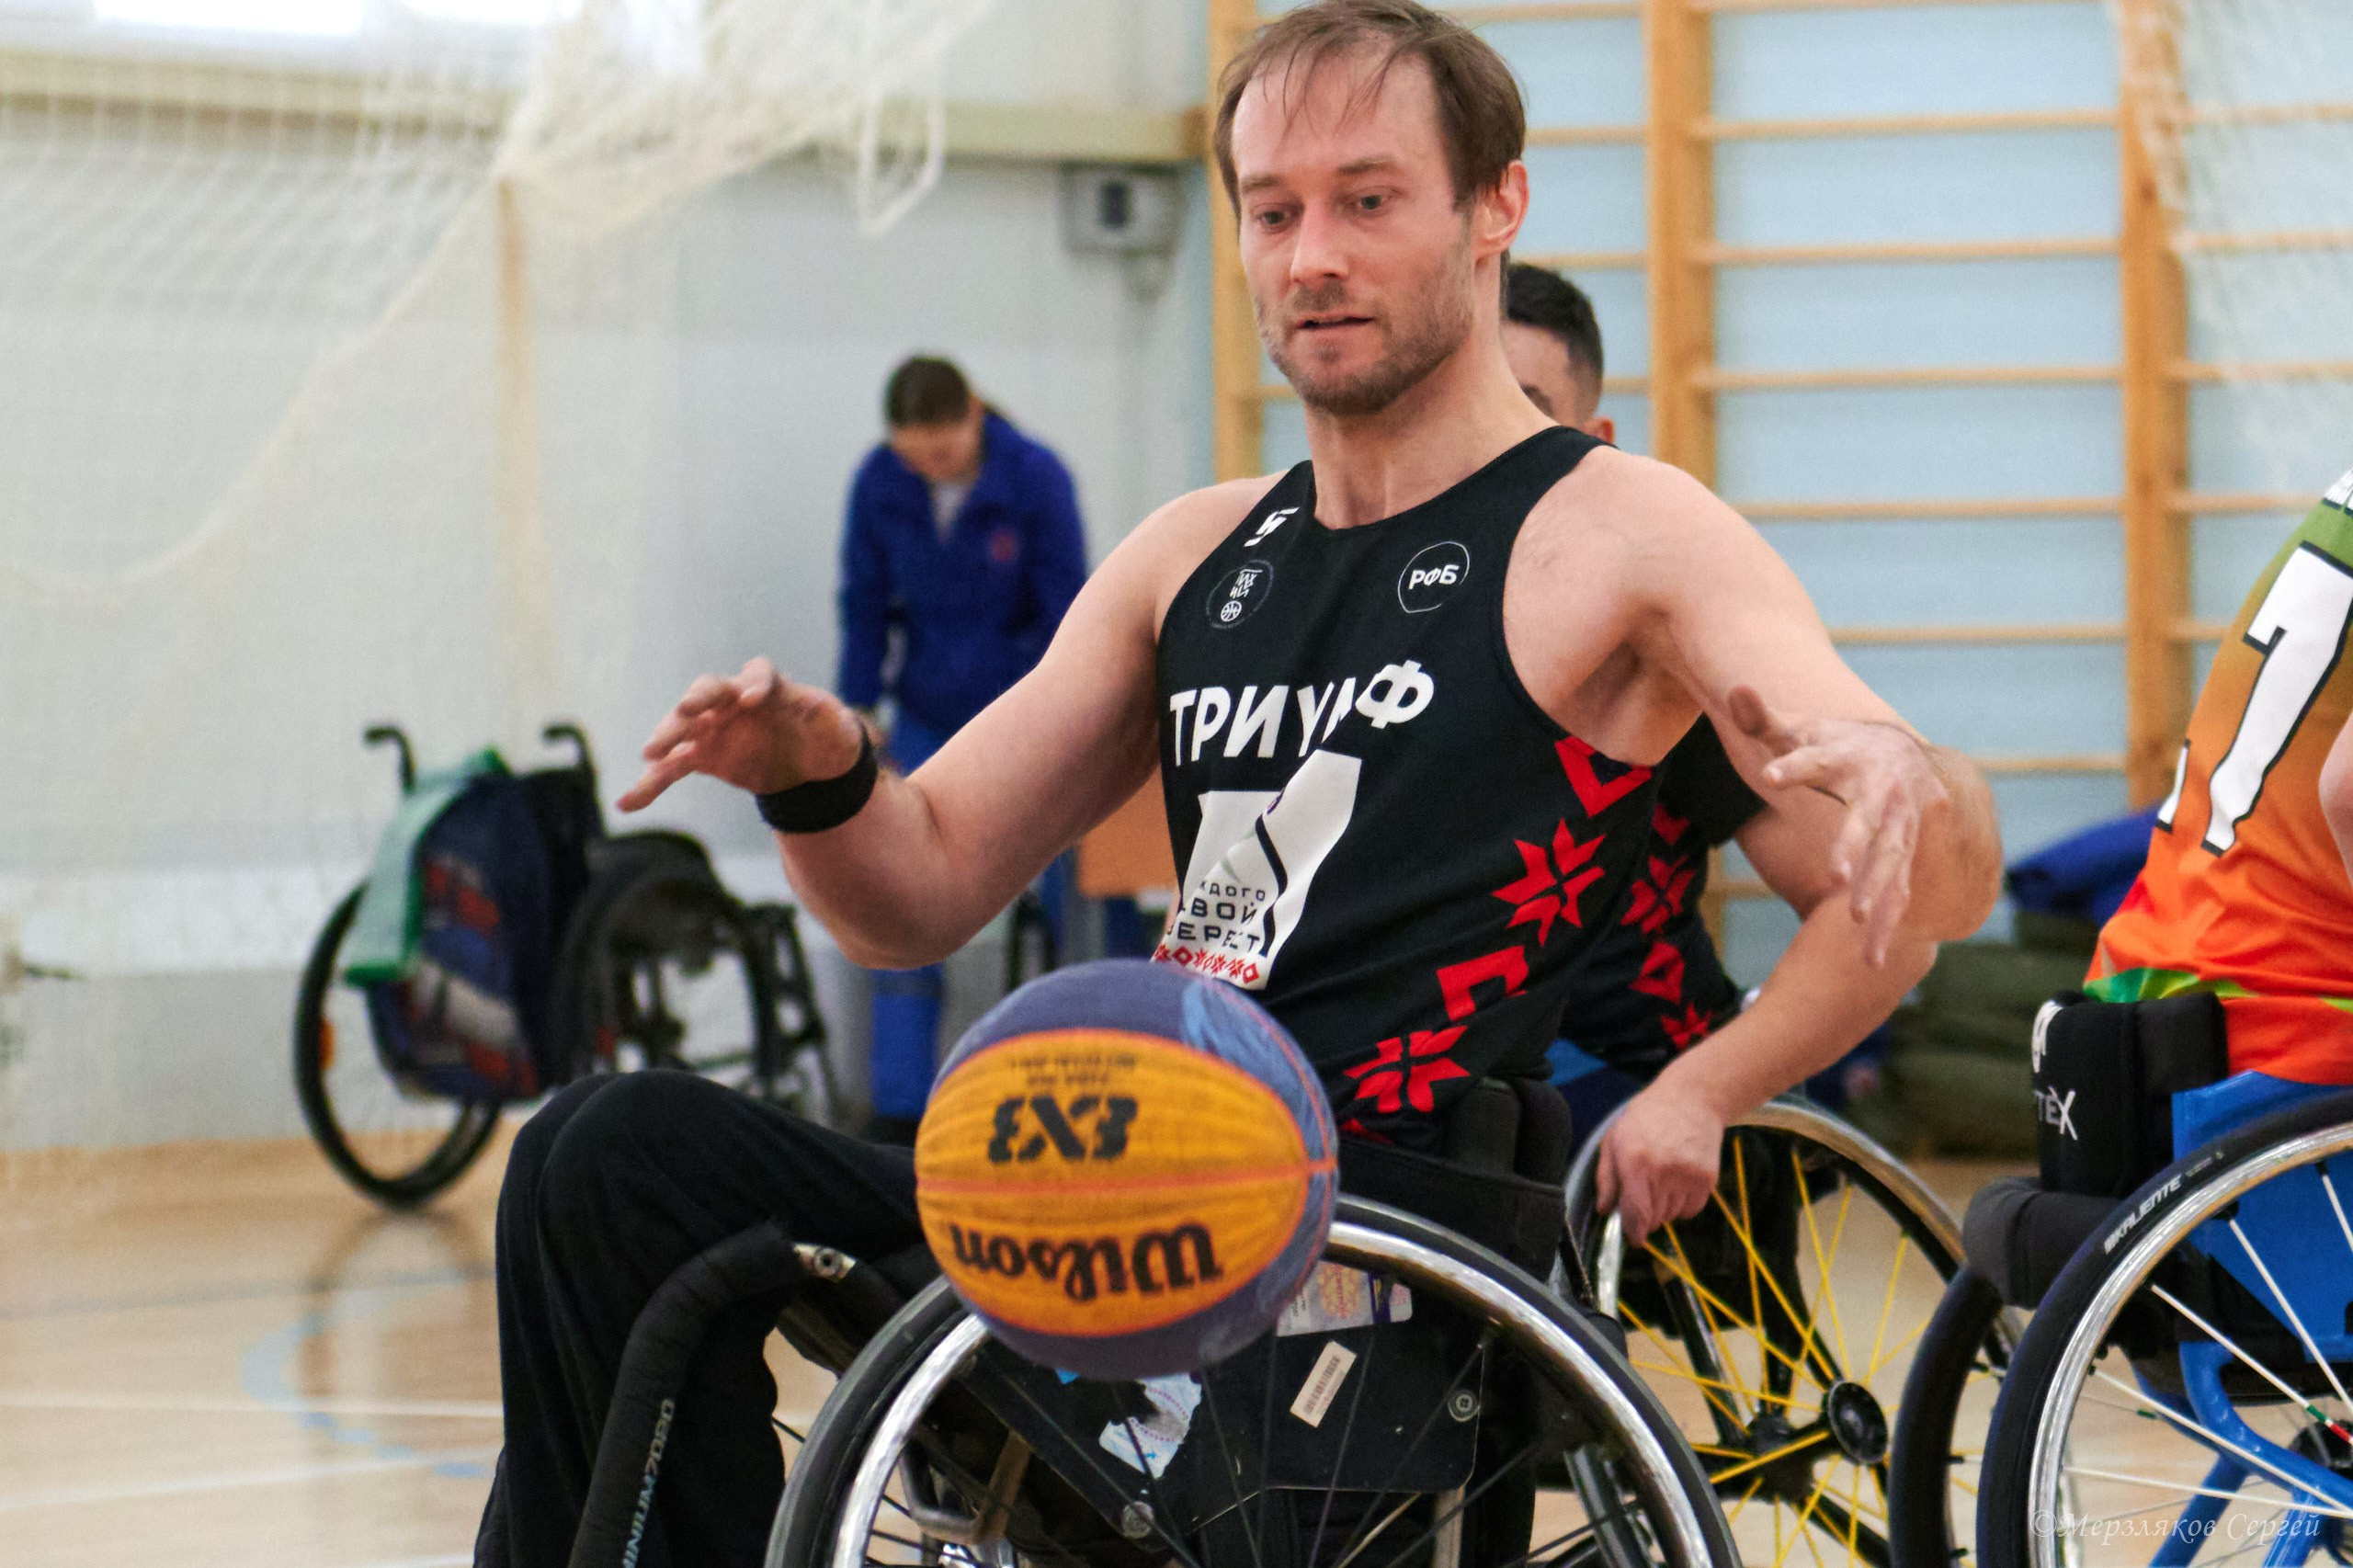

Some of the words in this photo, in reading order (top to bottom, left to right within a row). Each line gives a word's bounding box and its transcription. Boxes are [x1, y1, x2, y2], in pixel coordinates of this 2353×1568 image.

[1407, 563, 1461, 590] РФБ
[1181, 896, 1258, 925] ВОЙ
[948, 1218, 1224, 1304] Wilson
